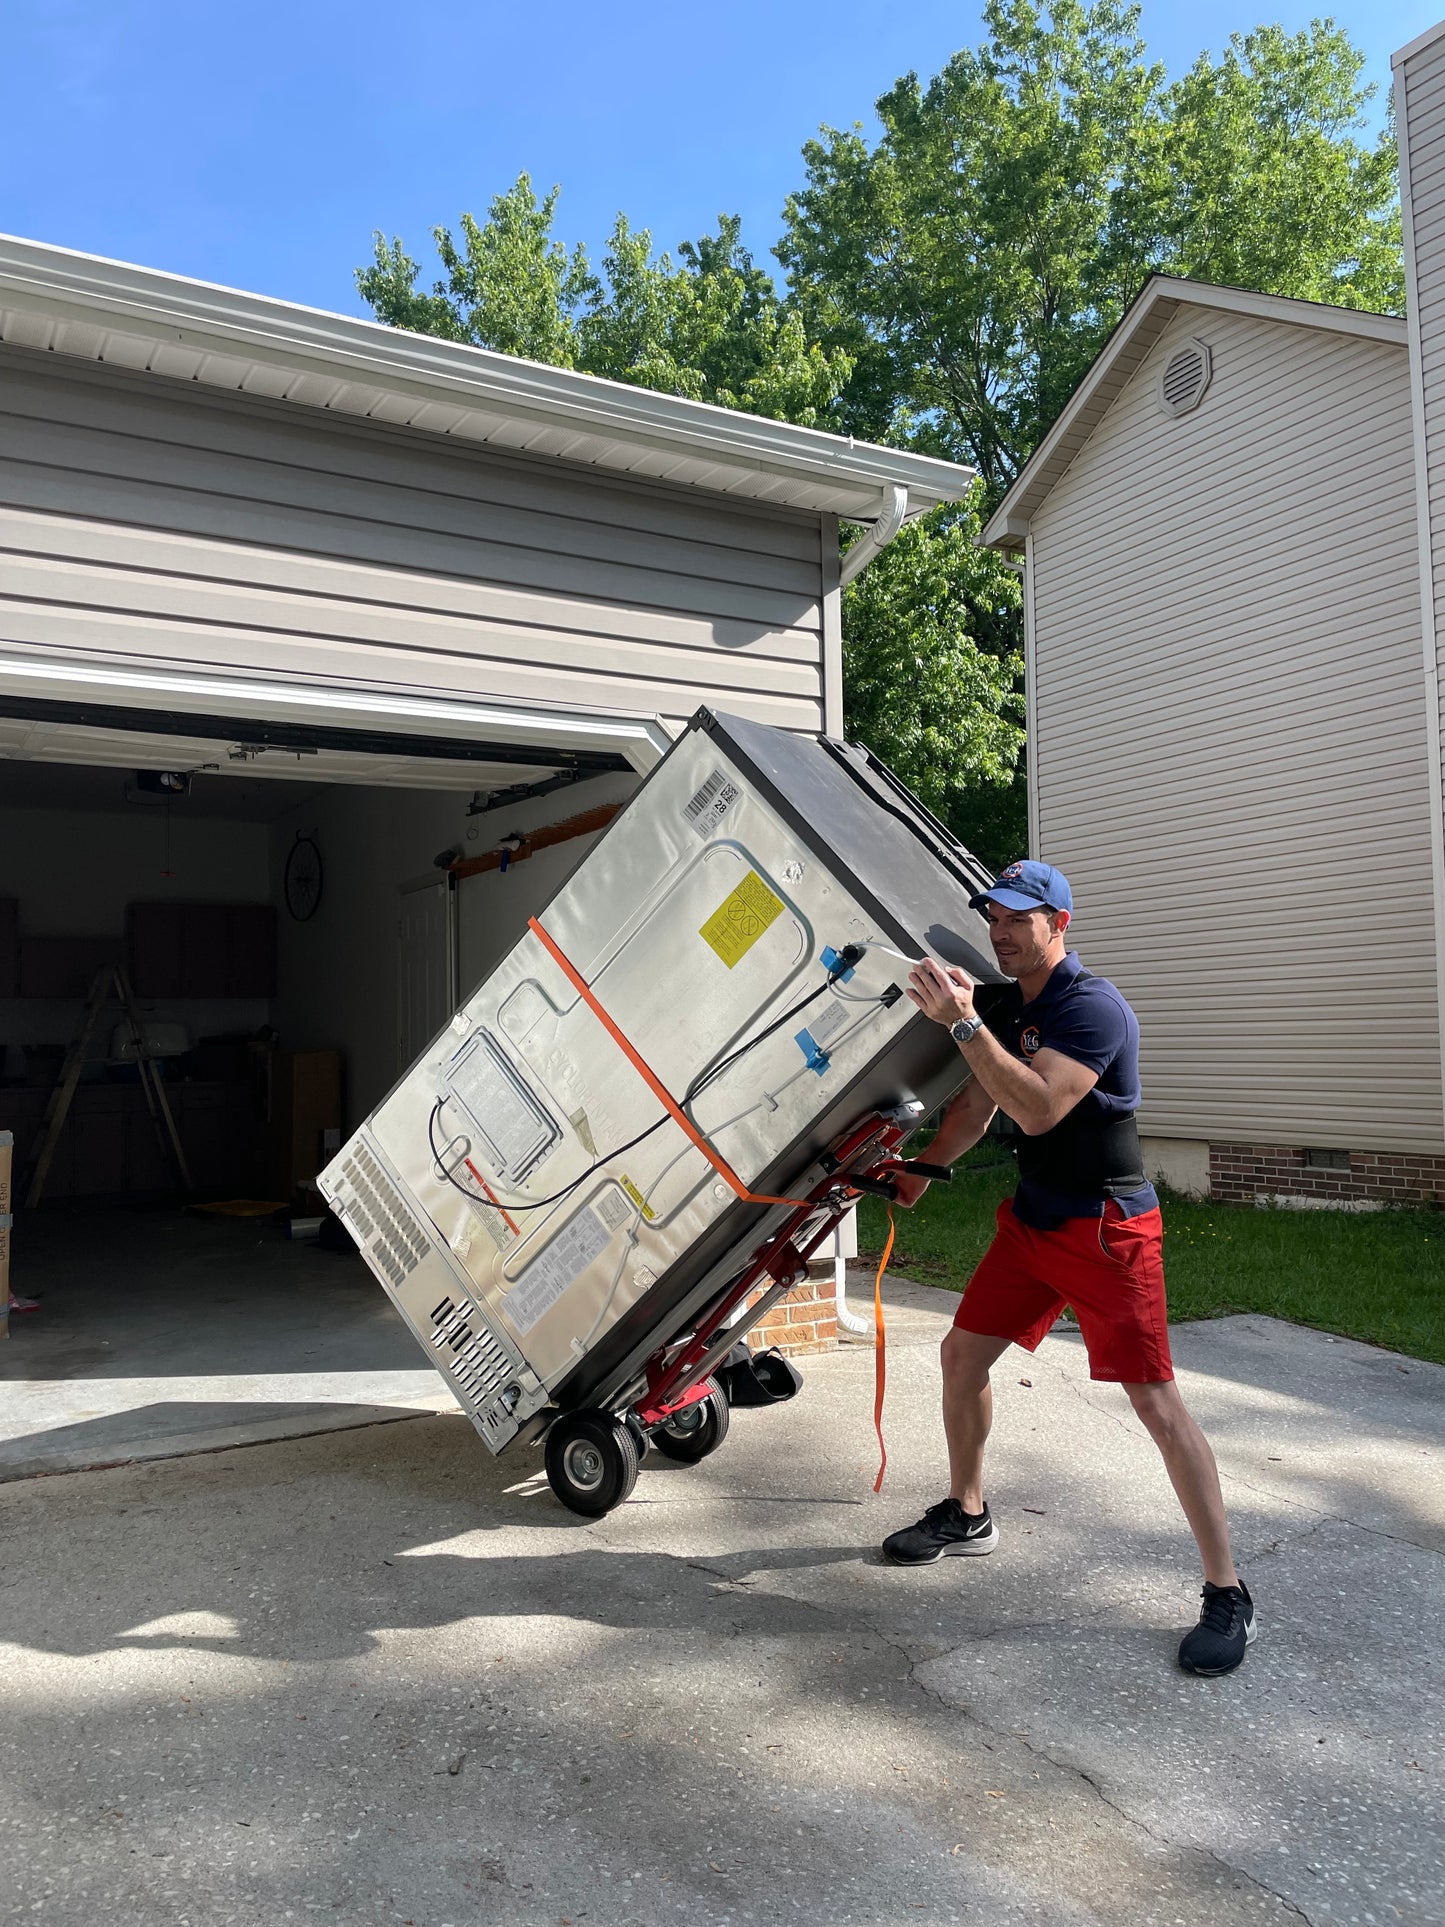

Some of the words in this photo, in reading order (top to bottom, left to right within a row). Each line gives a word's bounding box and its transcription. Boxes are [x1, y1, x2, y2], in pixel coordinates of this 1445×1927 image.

[714, 799, 727, 813] 28
[550, 1048, 627, 1147] CYCLOPENTAN
[0, 1182, 8, 1200] END
